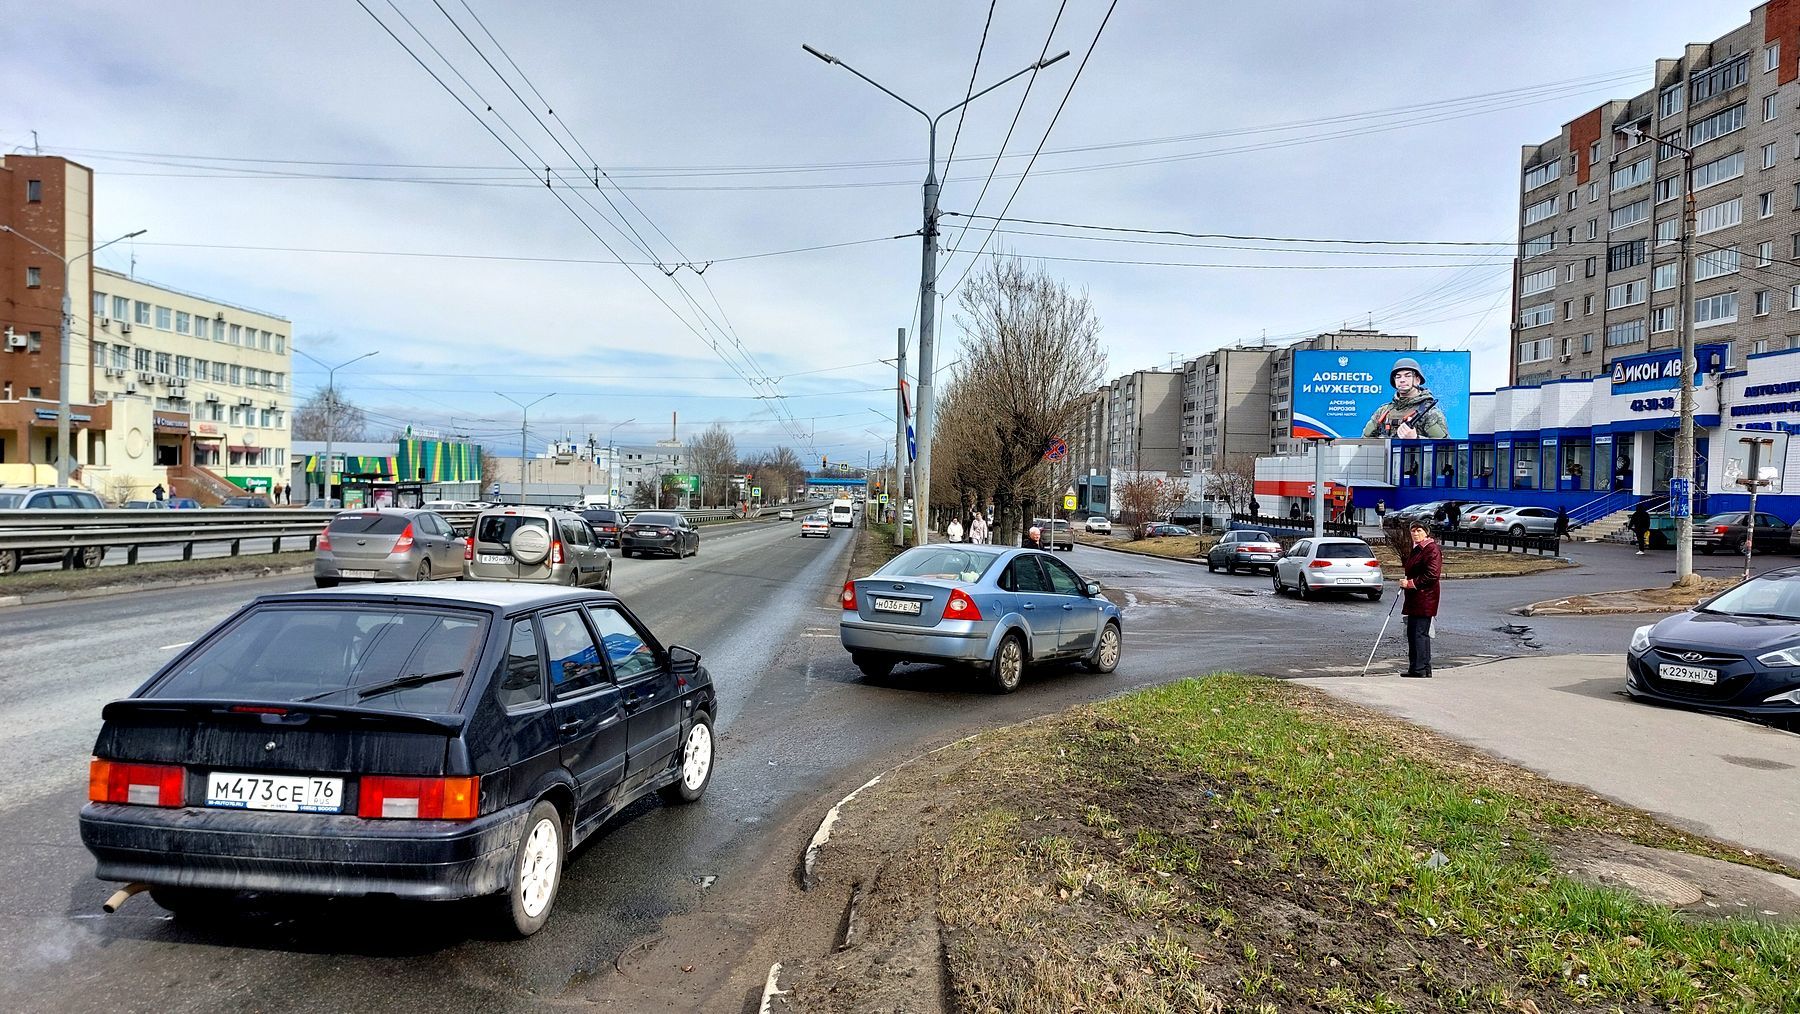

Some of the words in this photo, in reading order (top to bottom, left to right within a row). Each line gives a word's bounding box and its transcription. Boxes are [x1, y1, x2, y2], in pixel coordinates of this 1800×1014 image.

[1313, 372, 1374, 382] ДОБЛЕСТЬ
[1303, 384, 1312, 393] И
[1315, 384, 1382, 394] МУЖЕСТВО!
[878, 600, 908, 611] Н036РЕ
[1663, 666, 1700, 679] К229ХН
[1703, 670, 1714, 679] 76
[216, 777, 303, 803] М473СЕ
[314, 780, 334, 798] 76
